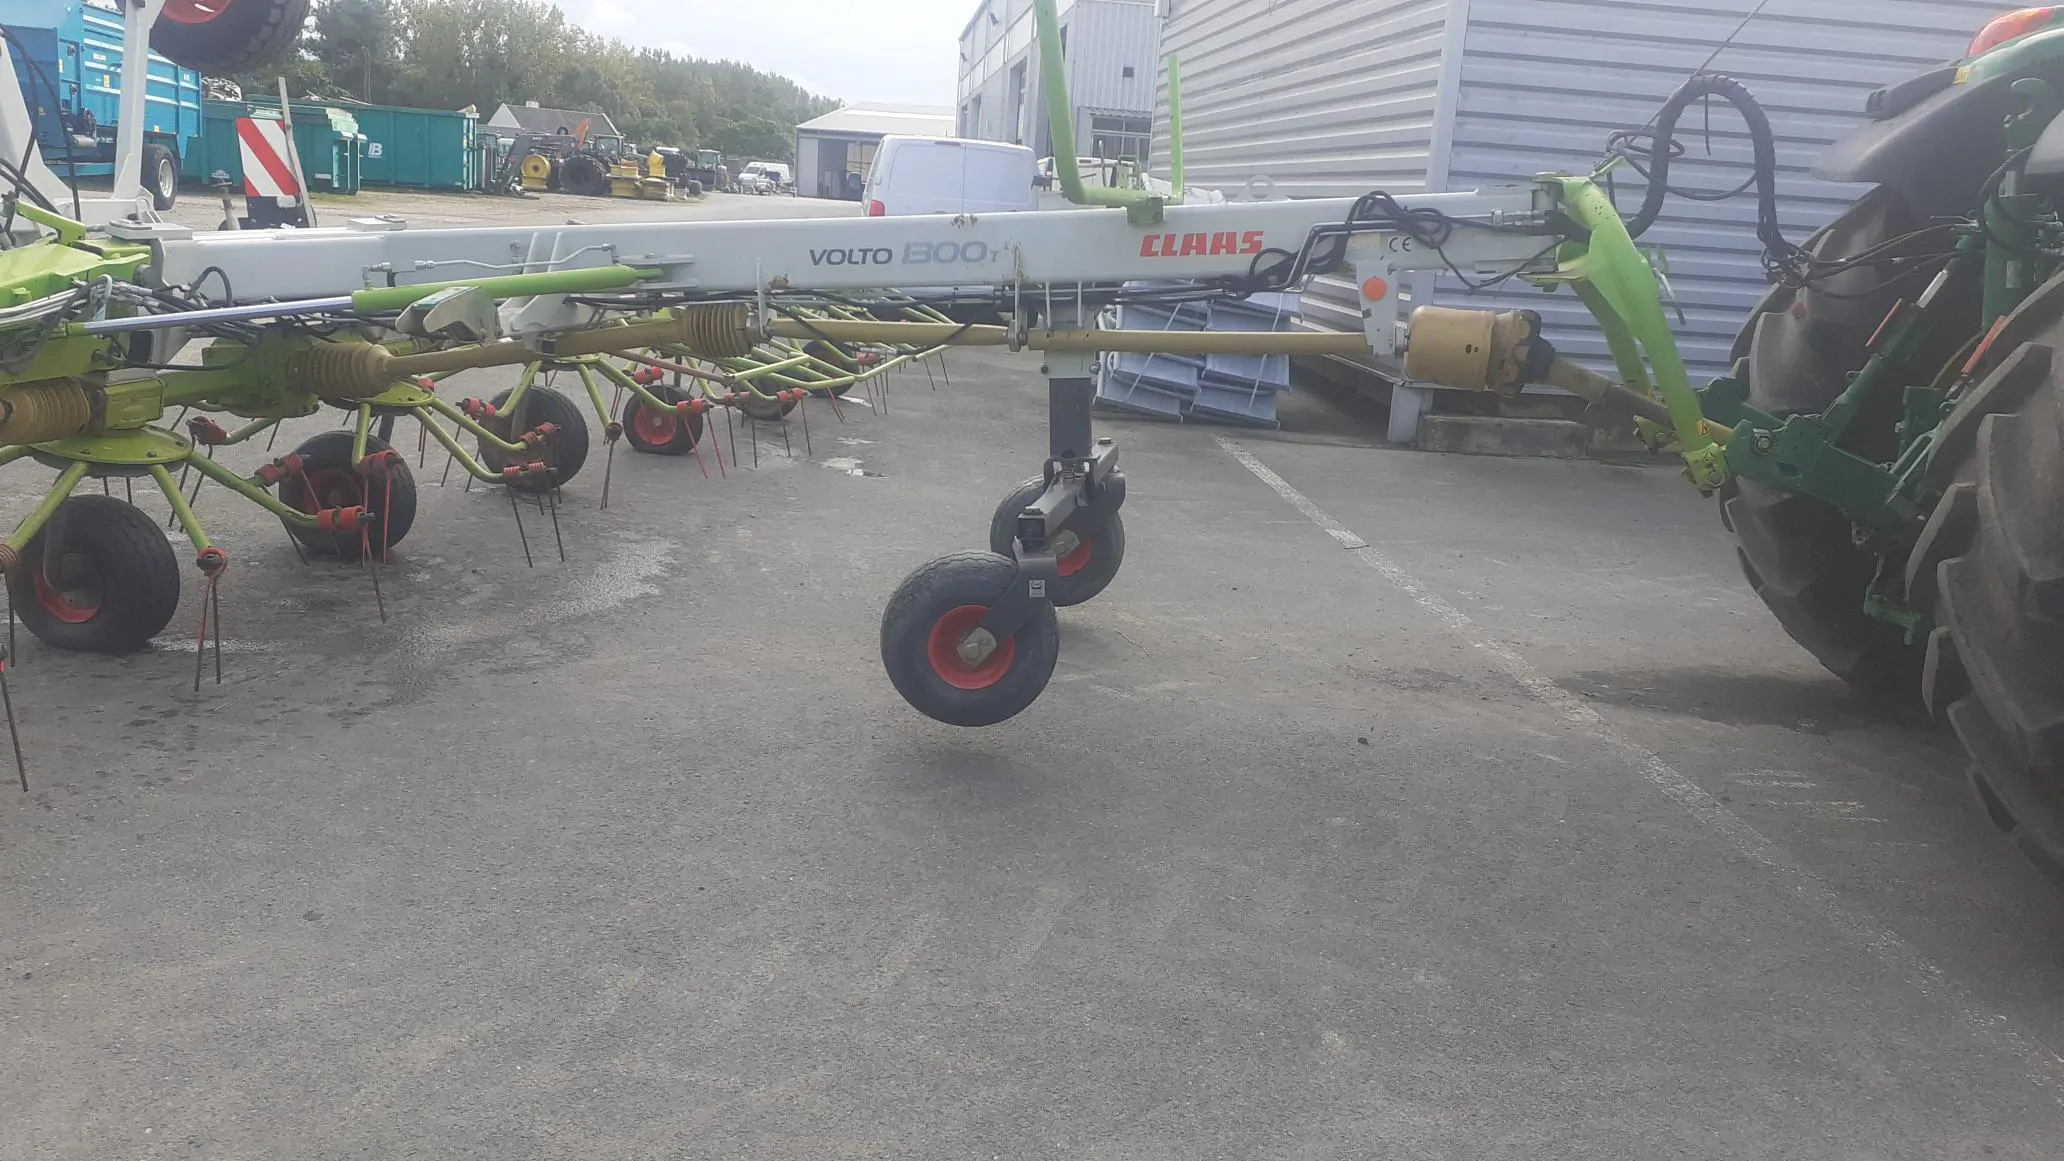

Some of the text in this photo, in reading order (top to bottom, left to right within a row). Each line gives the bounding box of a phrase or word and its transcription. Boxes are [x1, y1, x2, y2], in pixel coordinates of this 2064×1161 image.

[1140, 231, 1264, 256] CLAAS
[1389, 237, 1412, 252] CE
[809, 248, 893, 266] VOLTO
